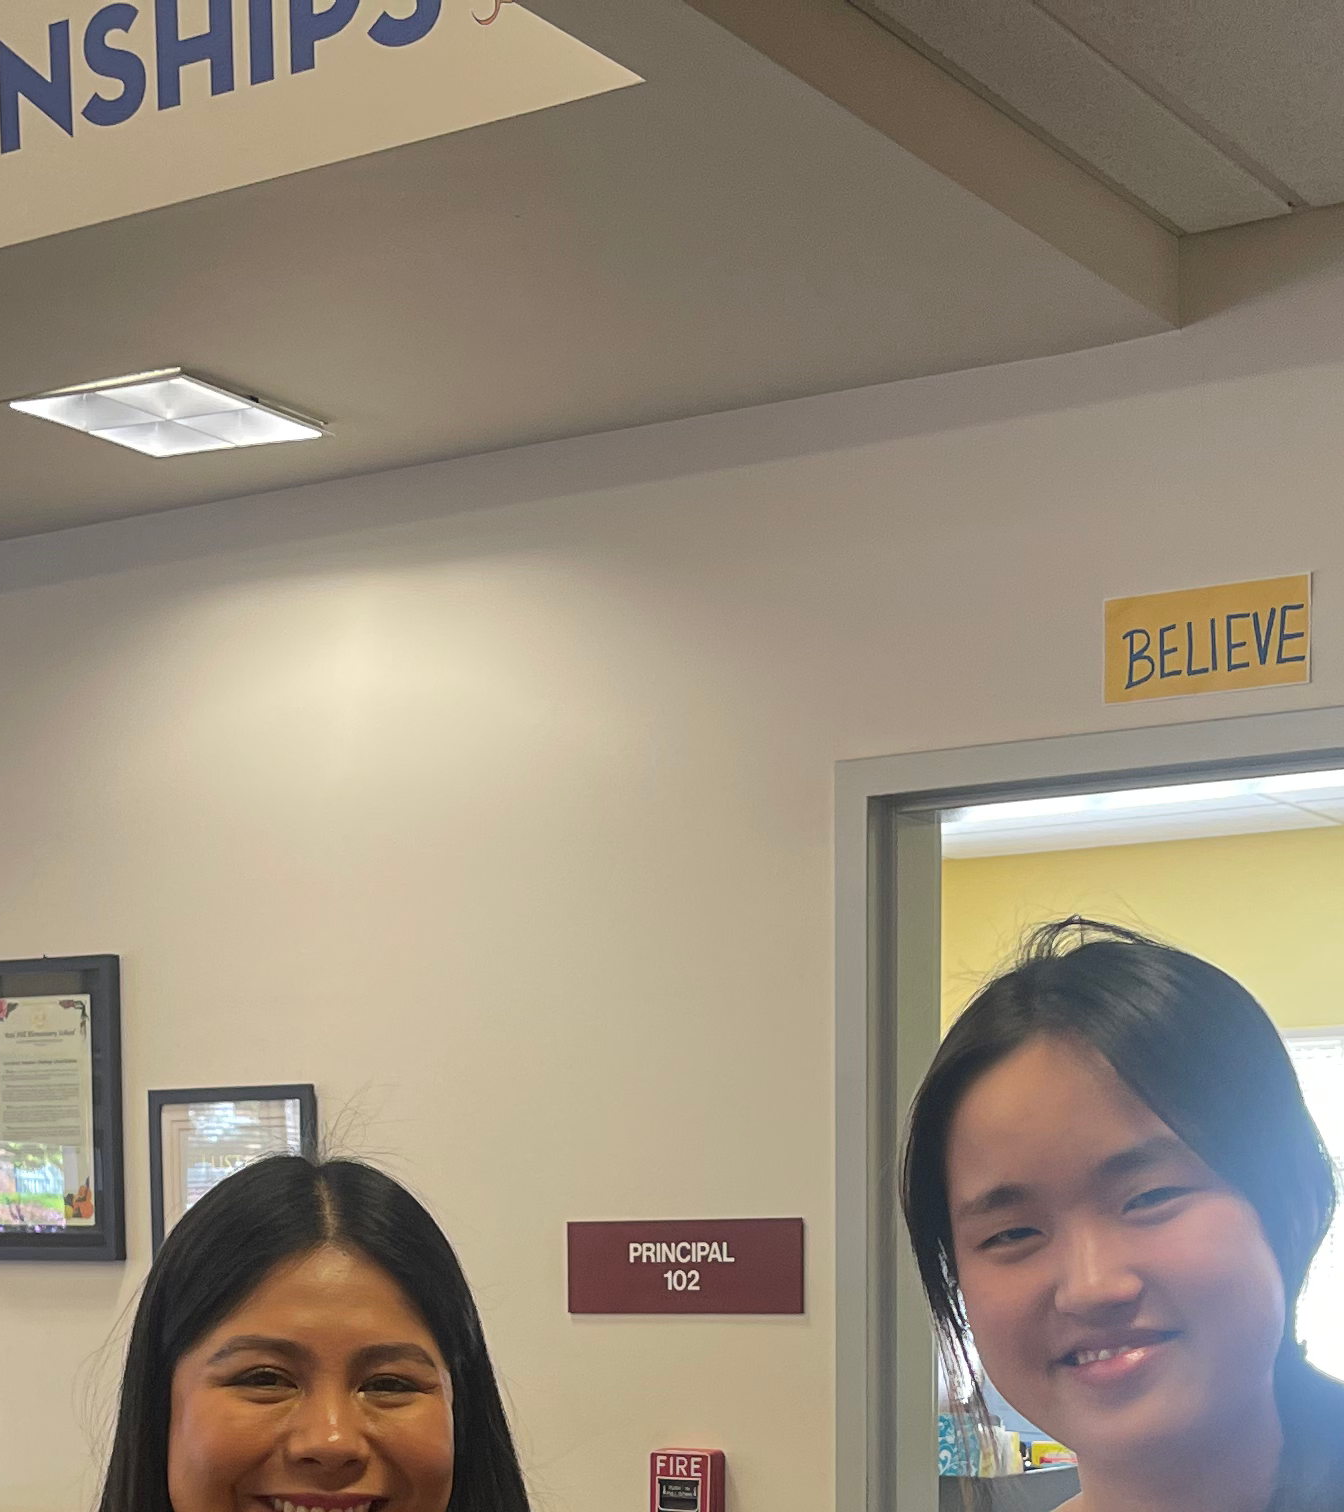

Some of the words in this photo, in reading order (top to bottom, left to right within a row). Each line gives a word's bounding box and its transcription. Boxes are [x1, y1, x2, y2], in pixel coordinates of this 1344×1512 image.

[1122, 603, 1306, 689] BELIEVE
[629, 1241, 735, 1263] PRINCIPAL
[663, 1269, 700, 1291] 102
[656, 1455, 702, 1477] FIRE
